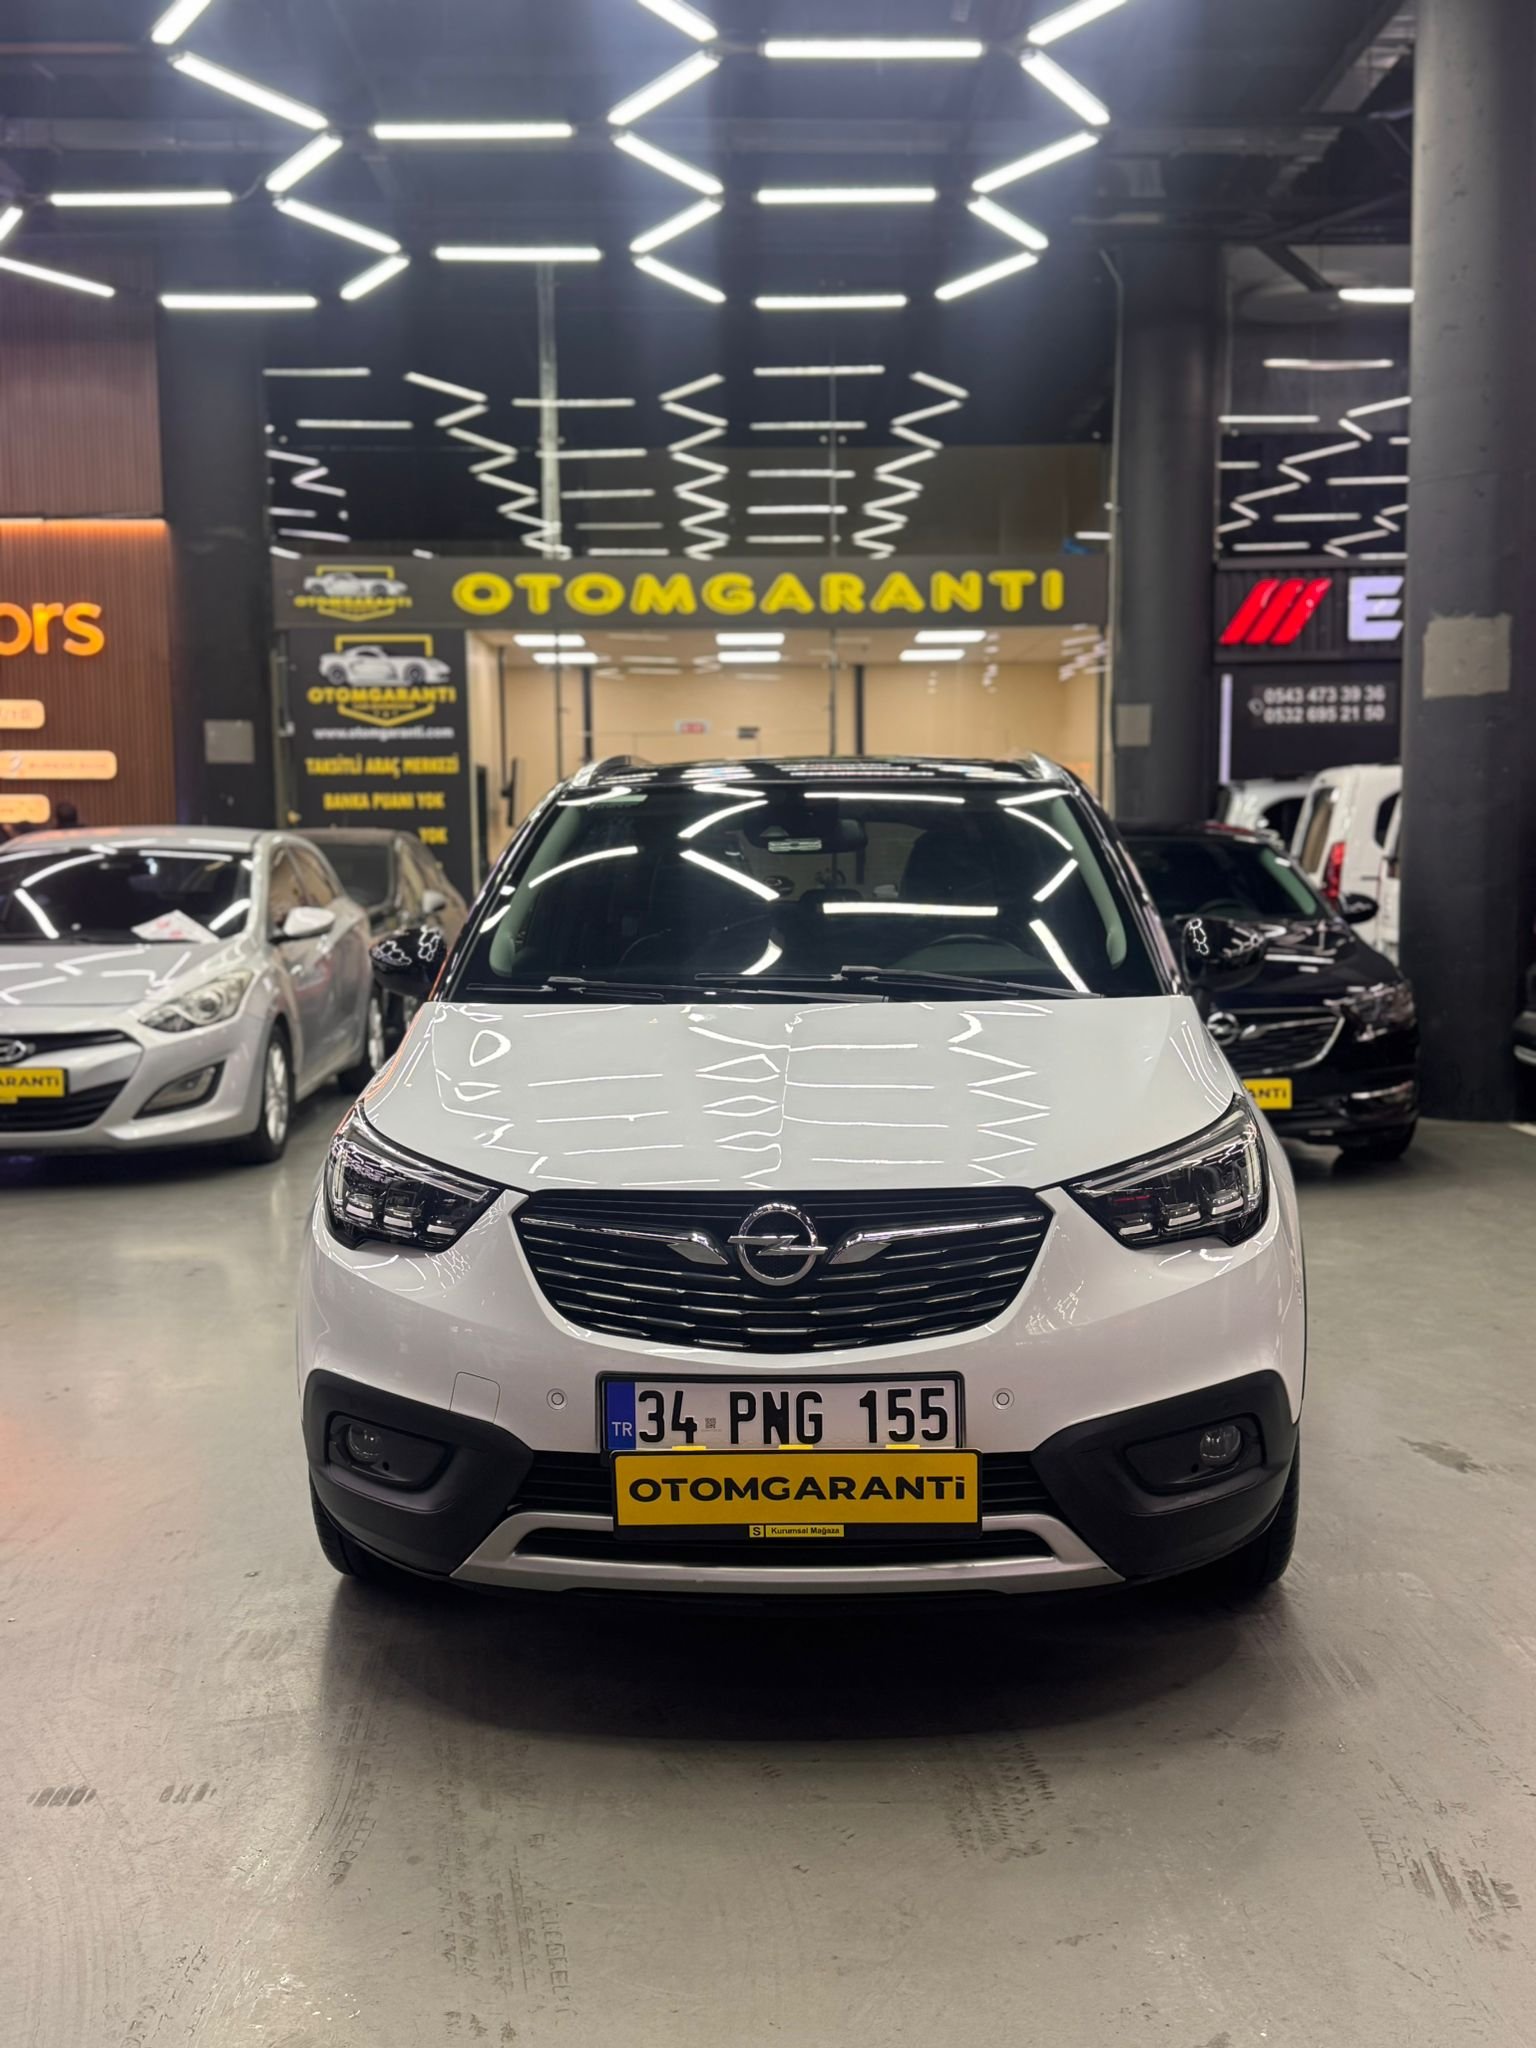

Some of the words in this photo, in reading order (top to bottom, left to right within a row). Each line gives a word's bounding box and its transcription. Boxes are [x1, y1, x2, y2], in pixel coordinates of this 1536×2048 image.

[452, 570, 1064, 616] OTOMGARANTI
[0, 602, 105, 656] ors
[307, 686, 457, 704] OTOMGARANTI
[416, 791, 446, 810] YOK
[417, 826, 448, 845] YOK
[638, 1389, 698, 1443] 34
[729, 1391, 823, 1445] PNG
[859, 1387, 948, 1443] 155
[611, 1421, 633, 1437] TR
[752, 1526, 761, 1536] S
[771, 1527, 809, 1535] Kurumsal
[810, 1526, 840, 1536] Mağaza
